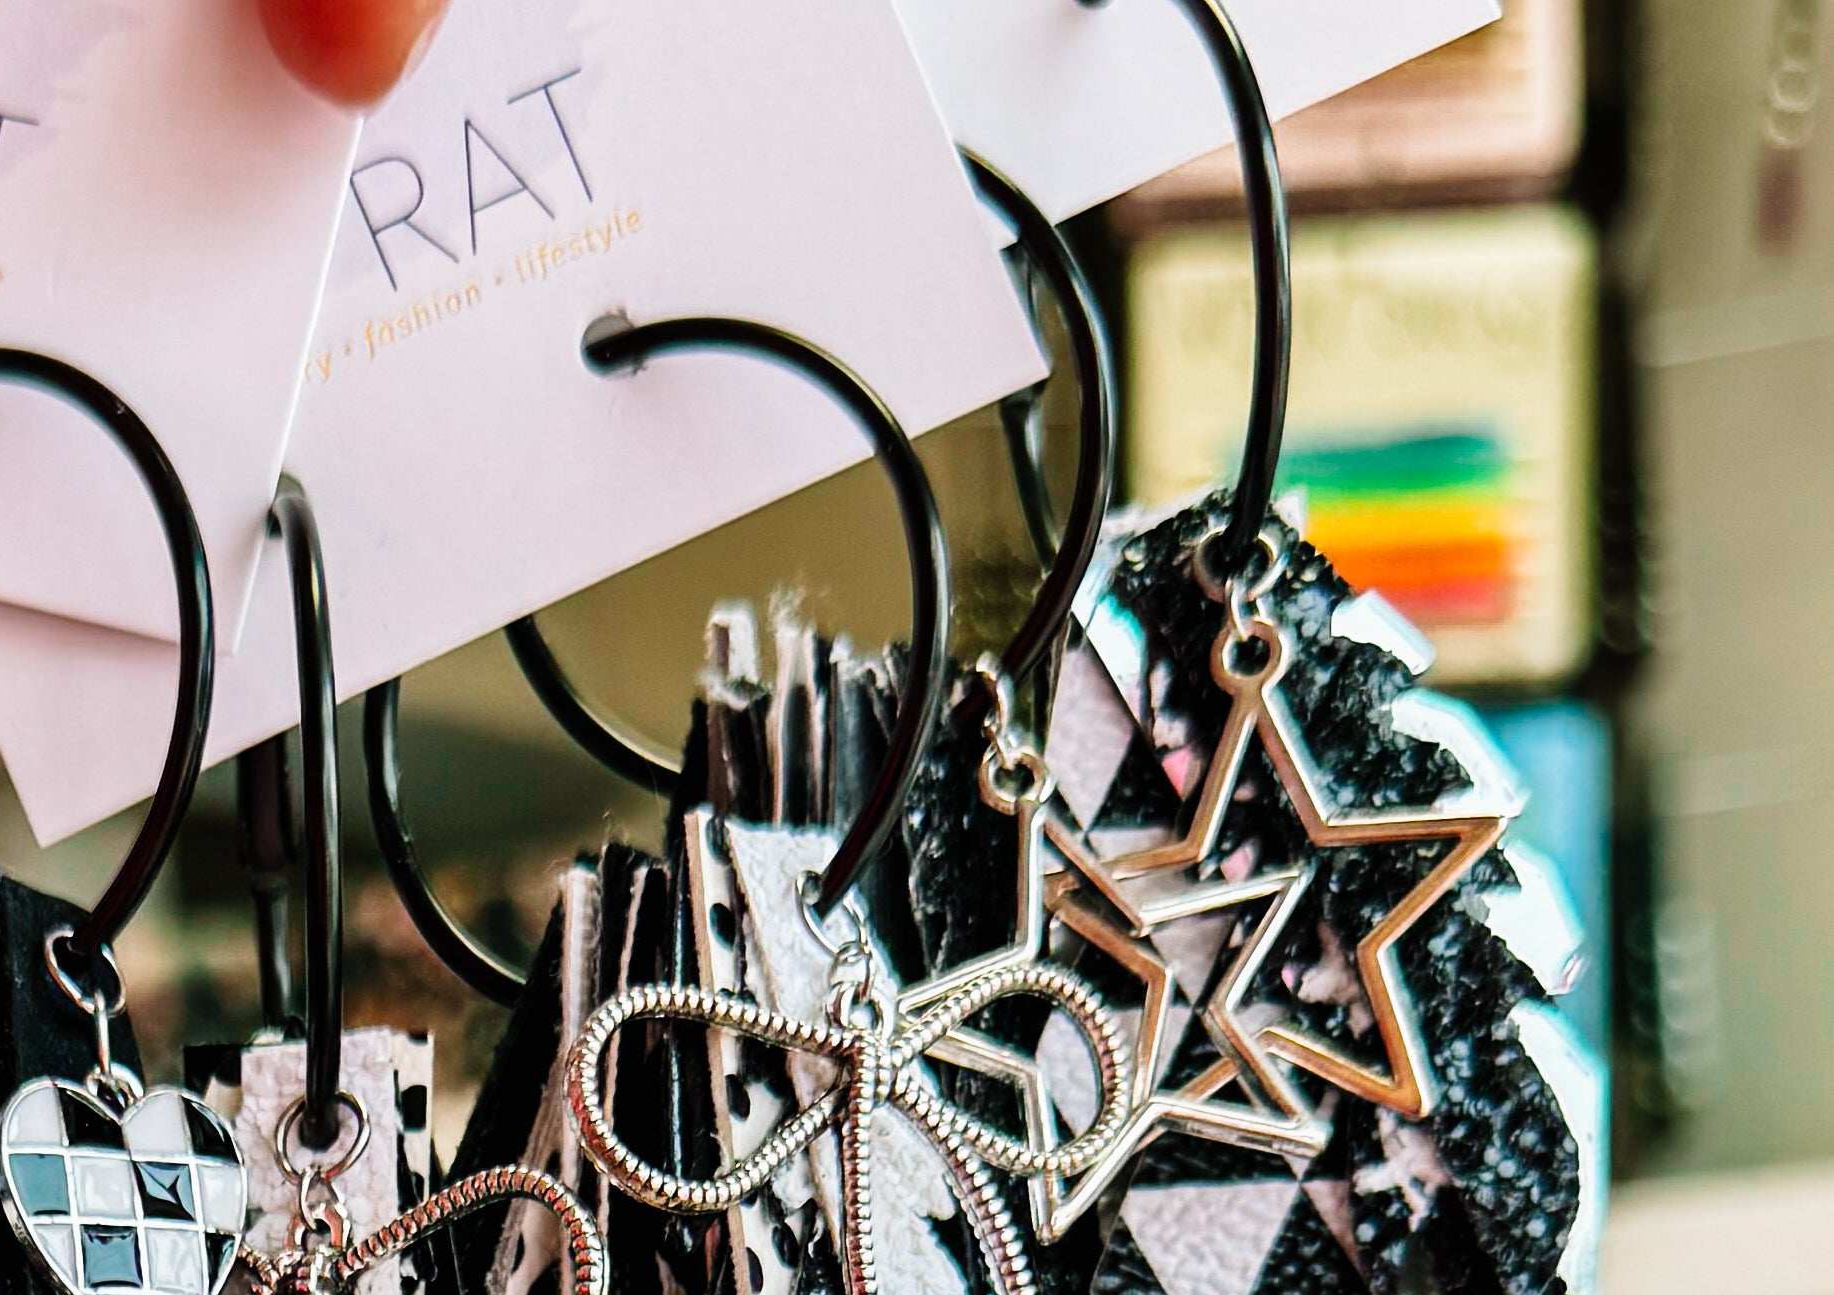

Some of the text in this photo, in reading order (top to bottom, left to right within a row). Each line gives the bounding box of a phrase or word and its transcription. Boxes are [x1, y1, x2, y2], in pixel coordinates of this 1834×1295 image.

[349, 68, 594, 291] RAT
[364, 206, 643, 363] fashion lifestyle
